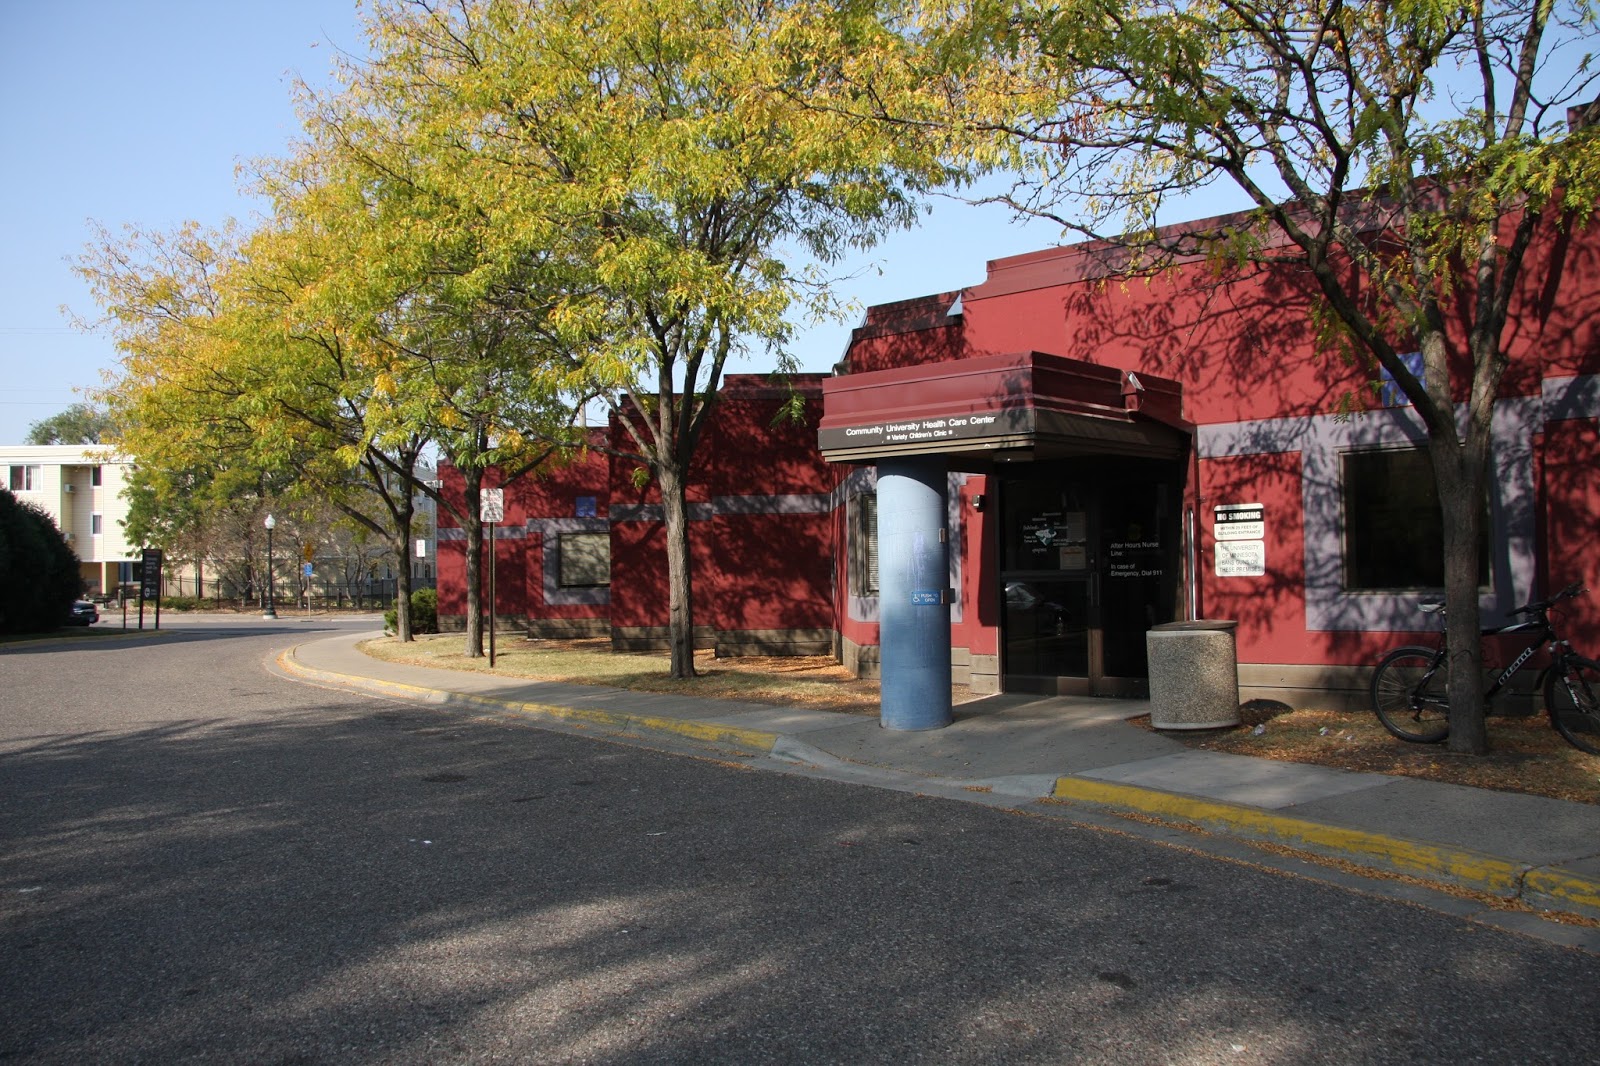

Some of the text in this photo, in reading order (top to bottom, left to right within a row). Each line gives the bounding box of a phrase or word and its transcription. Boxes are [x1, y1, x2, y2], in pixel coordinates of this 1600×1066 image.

[846, 426, 883, 436] Community
[886, 422, 920, 432] University
[923, 420, 946, 428] Health
[970, 416, 996, 424] Center
[1228, 512, 1261, 520] SMOKING
